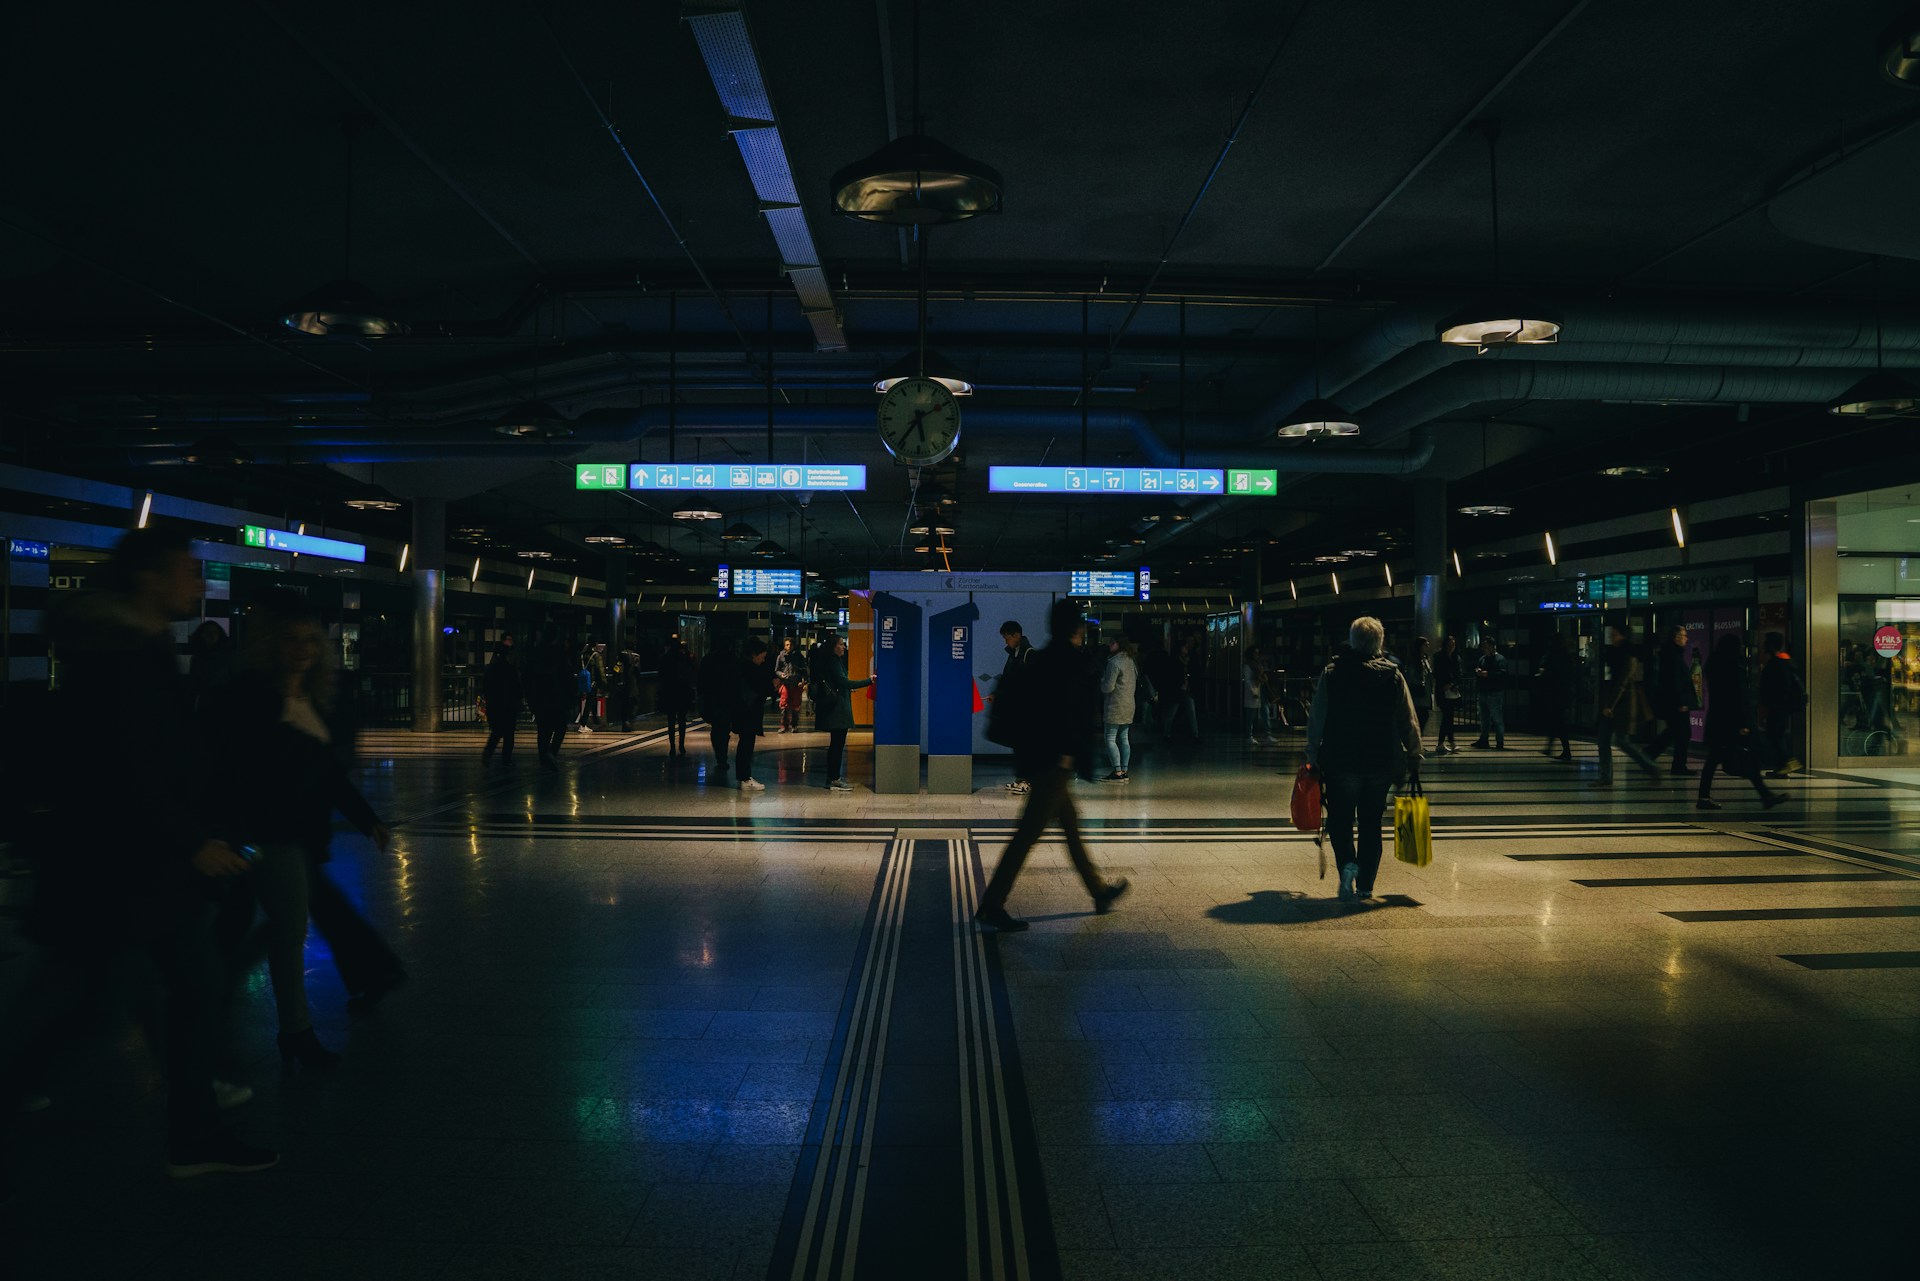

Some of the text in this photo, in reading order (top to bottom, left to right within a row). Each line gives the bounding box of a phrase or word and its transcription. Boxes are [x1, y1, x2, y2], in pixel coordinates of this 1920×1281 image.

[659, 473, 673, 485] 41
[695, 473, 712, 485] 44
[1072, 476, 1081, 488] 3
[1107, 477, 1121, 489] 17
[1144, 478, 1157, 489] 21
[1180, 478, 1196, 489] 34
[1648, 581, 1665, 596] THE
[1668, 577, 1698, 594] BODY
[1700, 575, 1730, 592] SHOP
